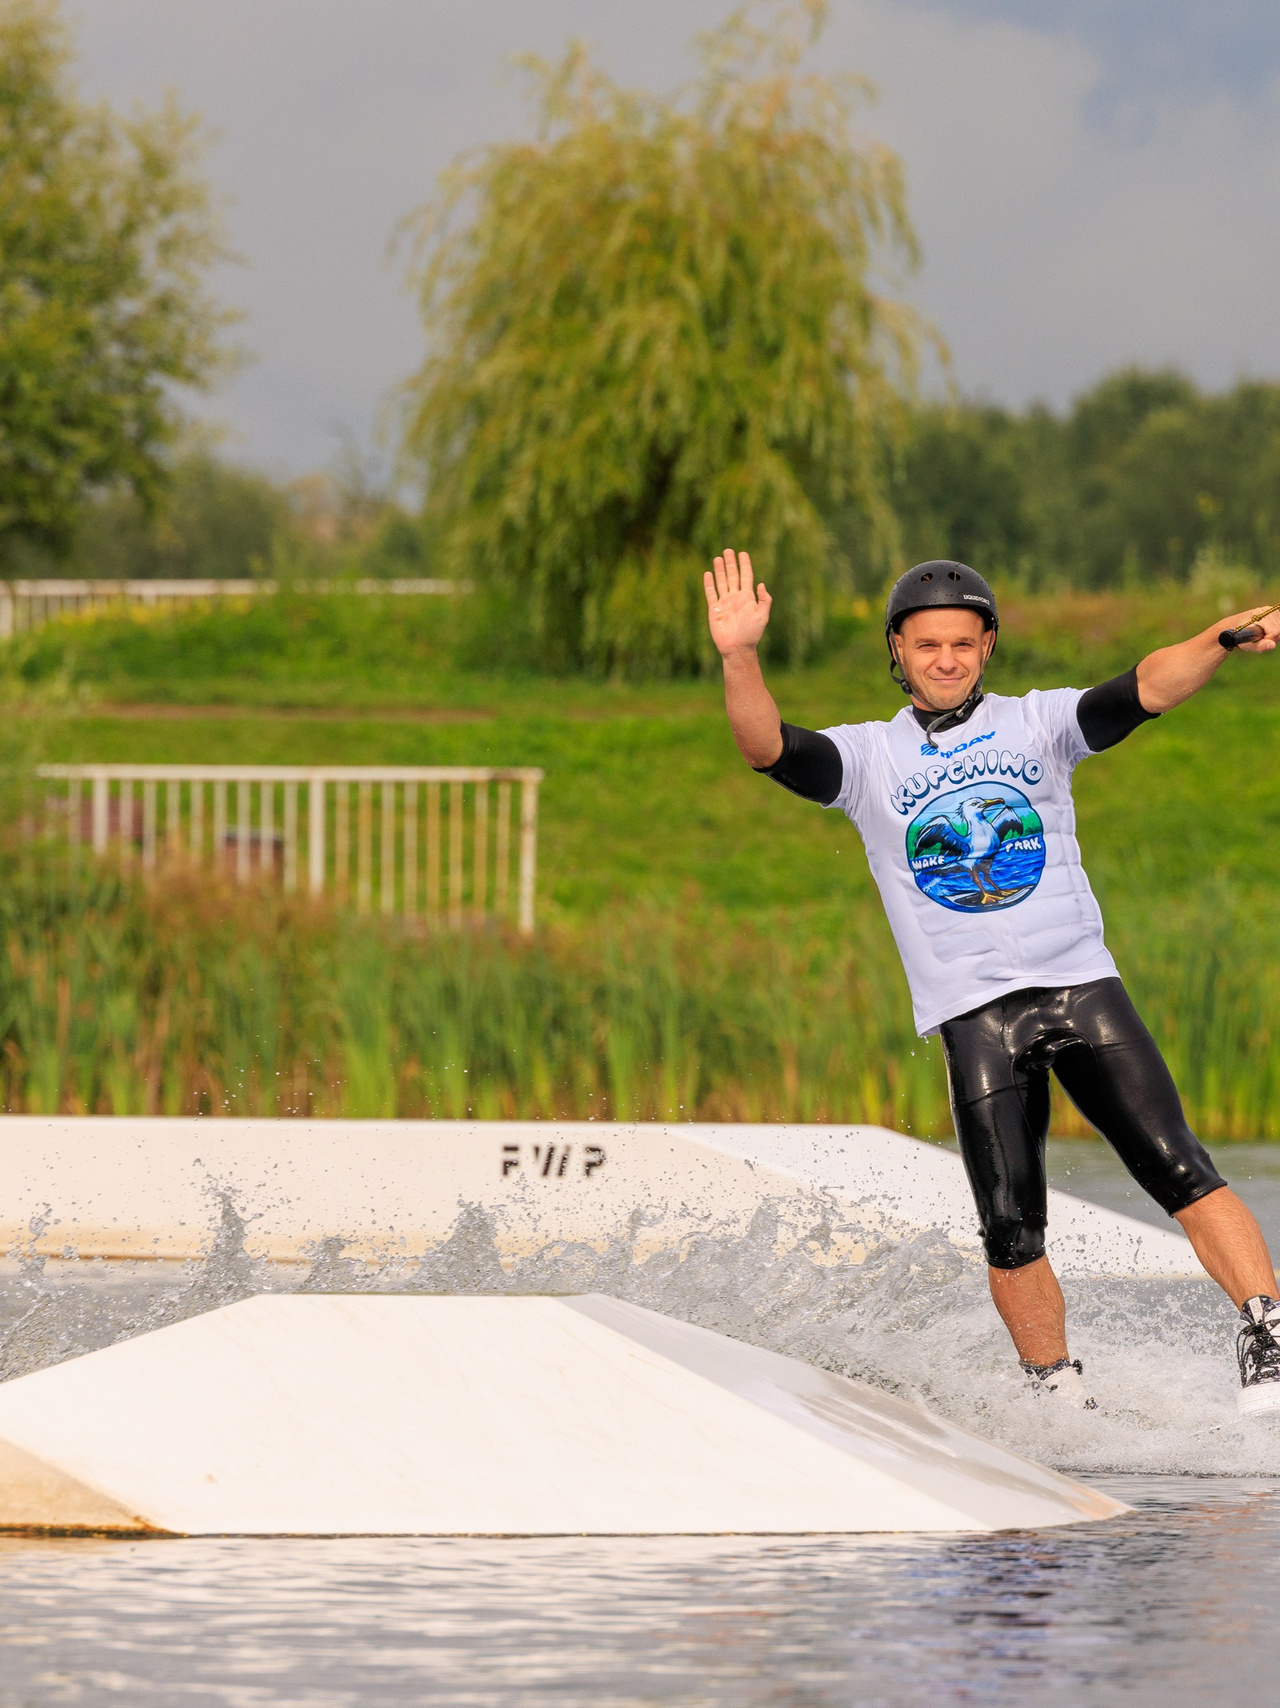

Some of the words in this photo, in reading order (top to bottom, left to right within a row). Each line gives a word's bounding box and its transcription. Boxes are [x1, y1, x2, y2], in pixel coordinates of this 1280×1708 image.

[890, 749, 1044, 815] KUPCHINO
[911, 855, 945, 870] WAKE
[1005, 836, 1042, 852] PARK
[503, 1146, 605, 1176] FWP
